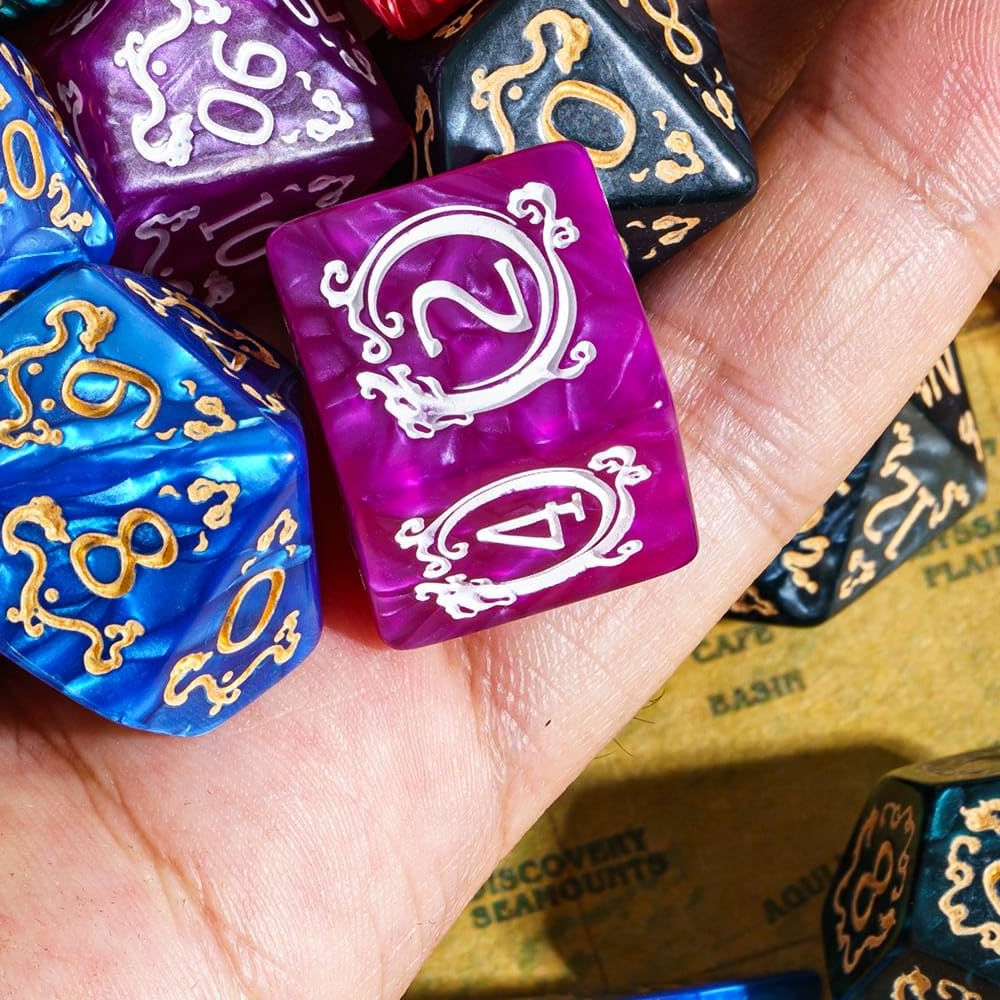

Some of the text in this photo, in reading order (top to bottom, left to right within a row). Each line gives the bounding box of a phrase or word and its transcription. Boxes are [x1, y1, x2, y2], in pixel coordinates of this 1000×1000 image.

[540, 80, 637, 169] 0
[411, 257, 533, 358] 2
[70, 507, 179, 600] 8
[475, 492, 586, 551] 4
[217, 567, 287, 655] 0
[706, 668, 807, 717] BASIN
[470, 851, 671, 929] SEAMOUNTS
[852, 840, 894, 933] 8
